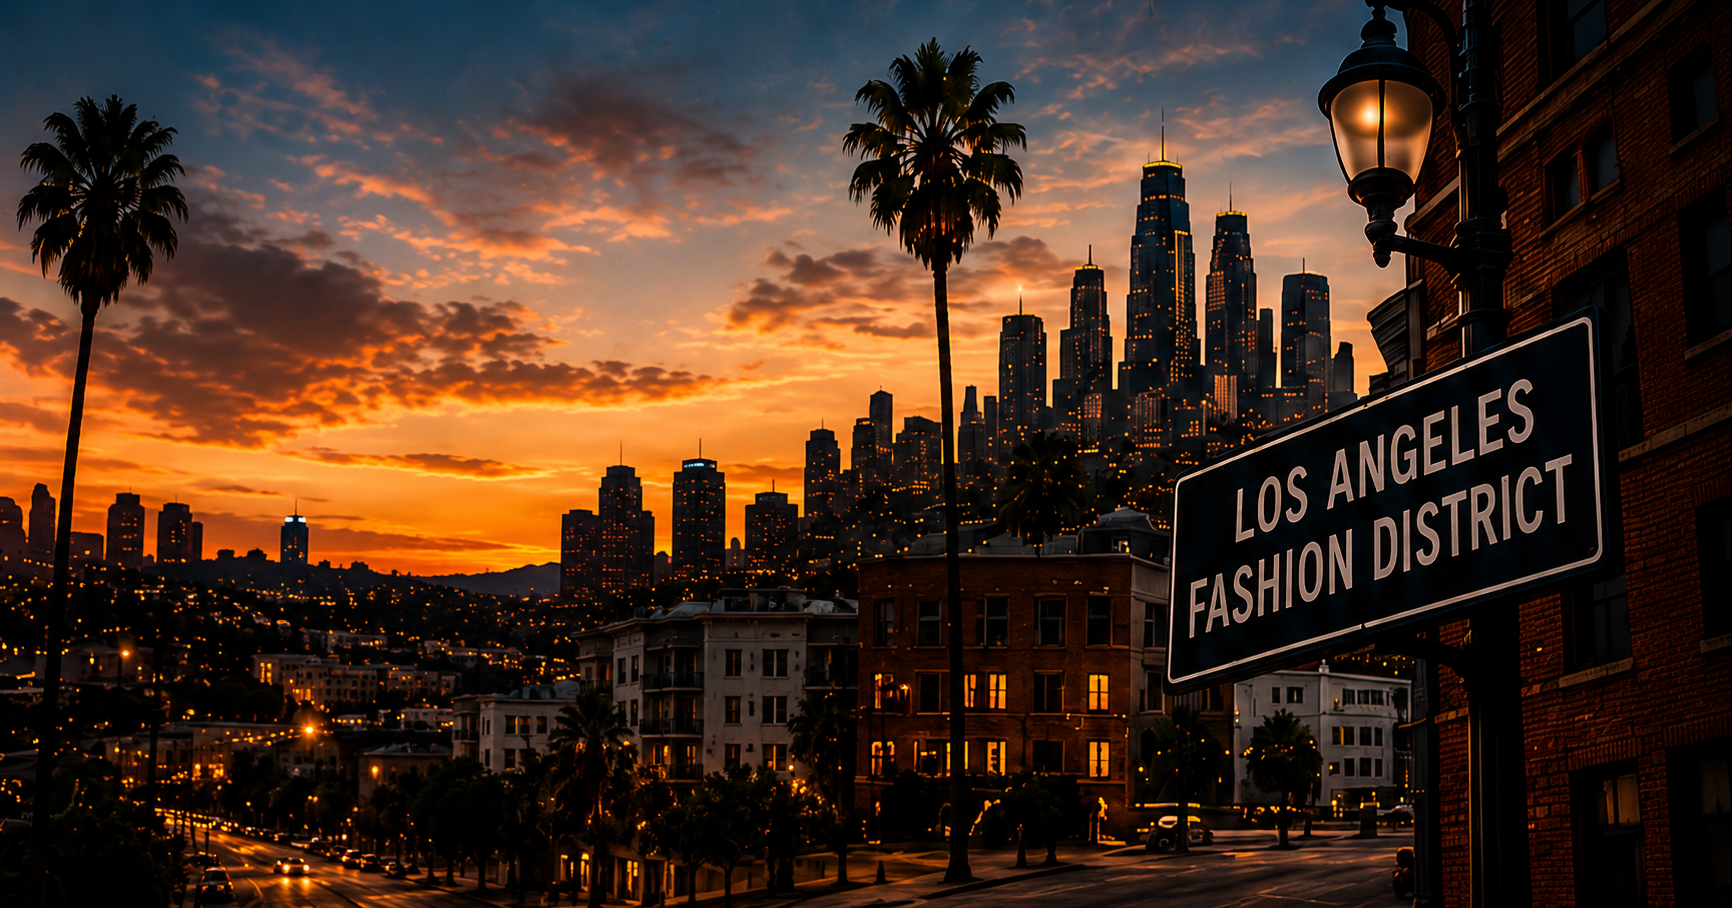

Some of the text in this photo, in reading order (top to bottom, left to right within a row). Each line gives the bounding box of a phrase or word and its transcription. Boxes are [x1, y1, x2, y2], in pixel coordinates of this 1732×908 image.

[1189, 454, 1573, 639] FASHION DISTRICT
[1235, 379, 1534, 543] LOS ANGELES
